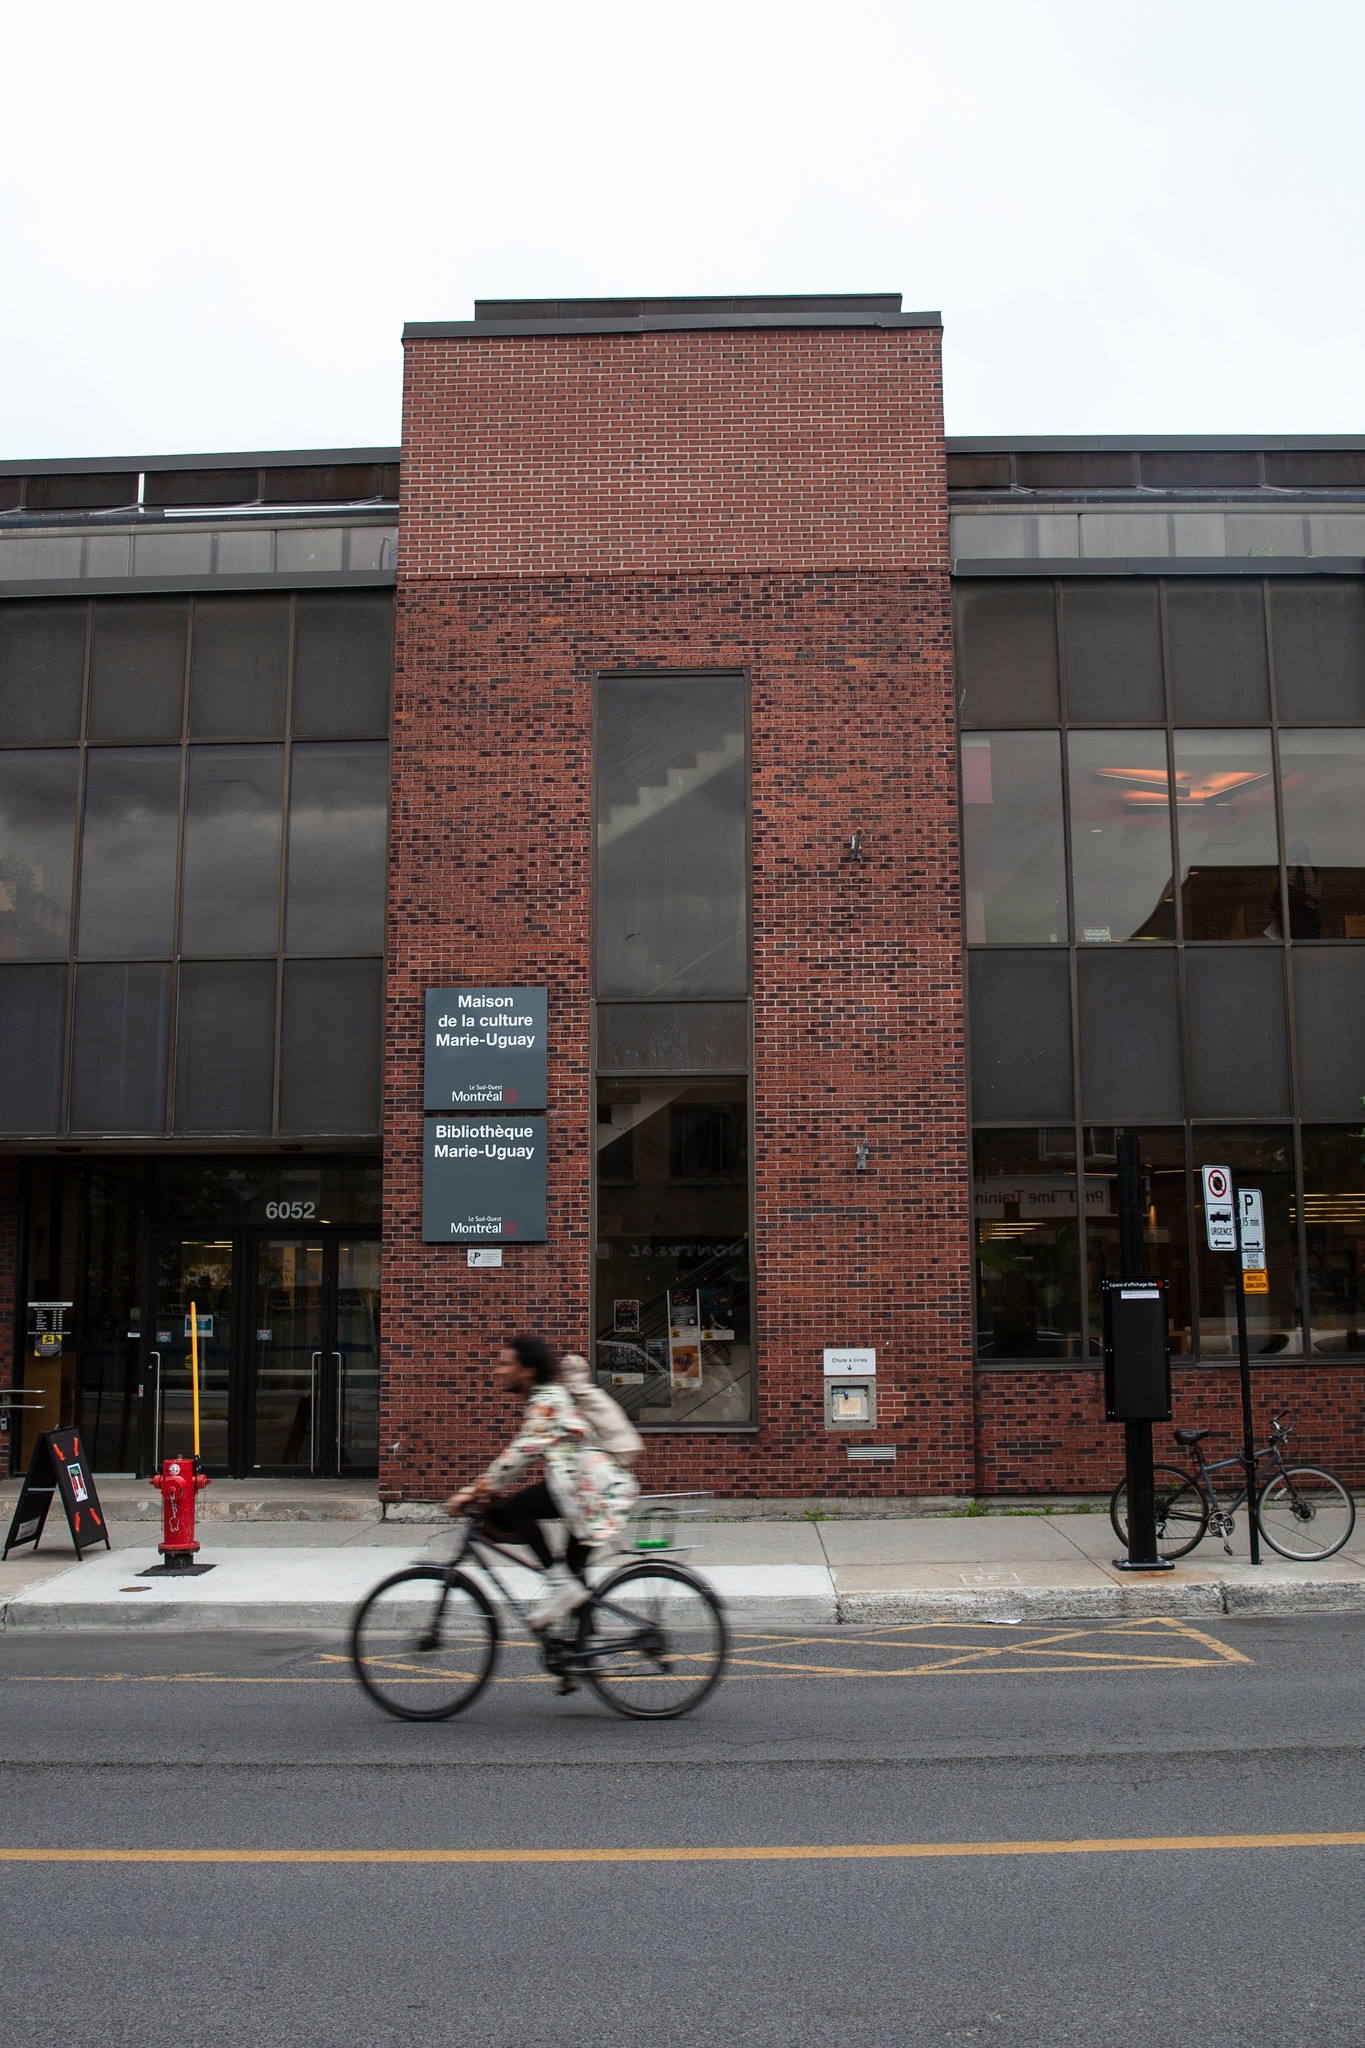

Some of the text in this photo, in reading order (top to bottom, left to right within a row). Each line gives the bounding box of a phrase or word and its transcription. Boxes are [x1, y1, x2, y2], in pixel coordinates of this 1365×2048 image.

[458, 995, 514, 1008] Maison
[438, 1013, 533, 1027] de la culture
[436, 1033, 536, 1049] Marie-Uguay
[451, 1090, 503, 1102] Montréal
[436, 1125, 534, 1140] Bibliothèque
[434, 1144, 535, 1160] Marie-Uguay
[265, 1201, 316, 1219] 6052
[1244, 1194, 1253, 1215] P
[450, 1222, 502, 1234] Montréal
[1241, 1217, 1260, 1227] 15 min
[1210, 1227, 1233, 1236] URGENCE
